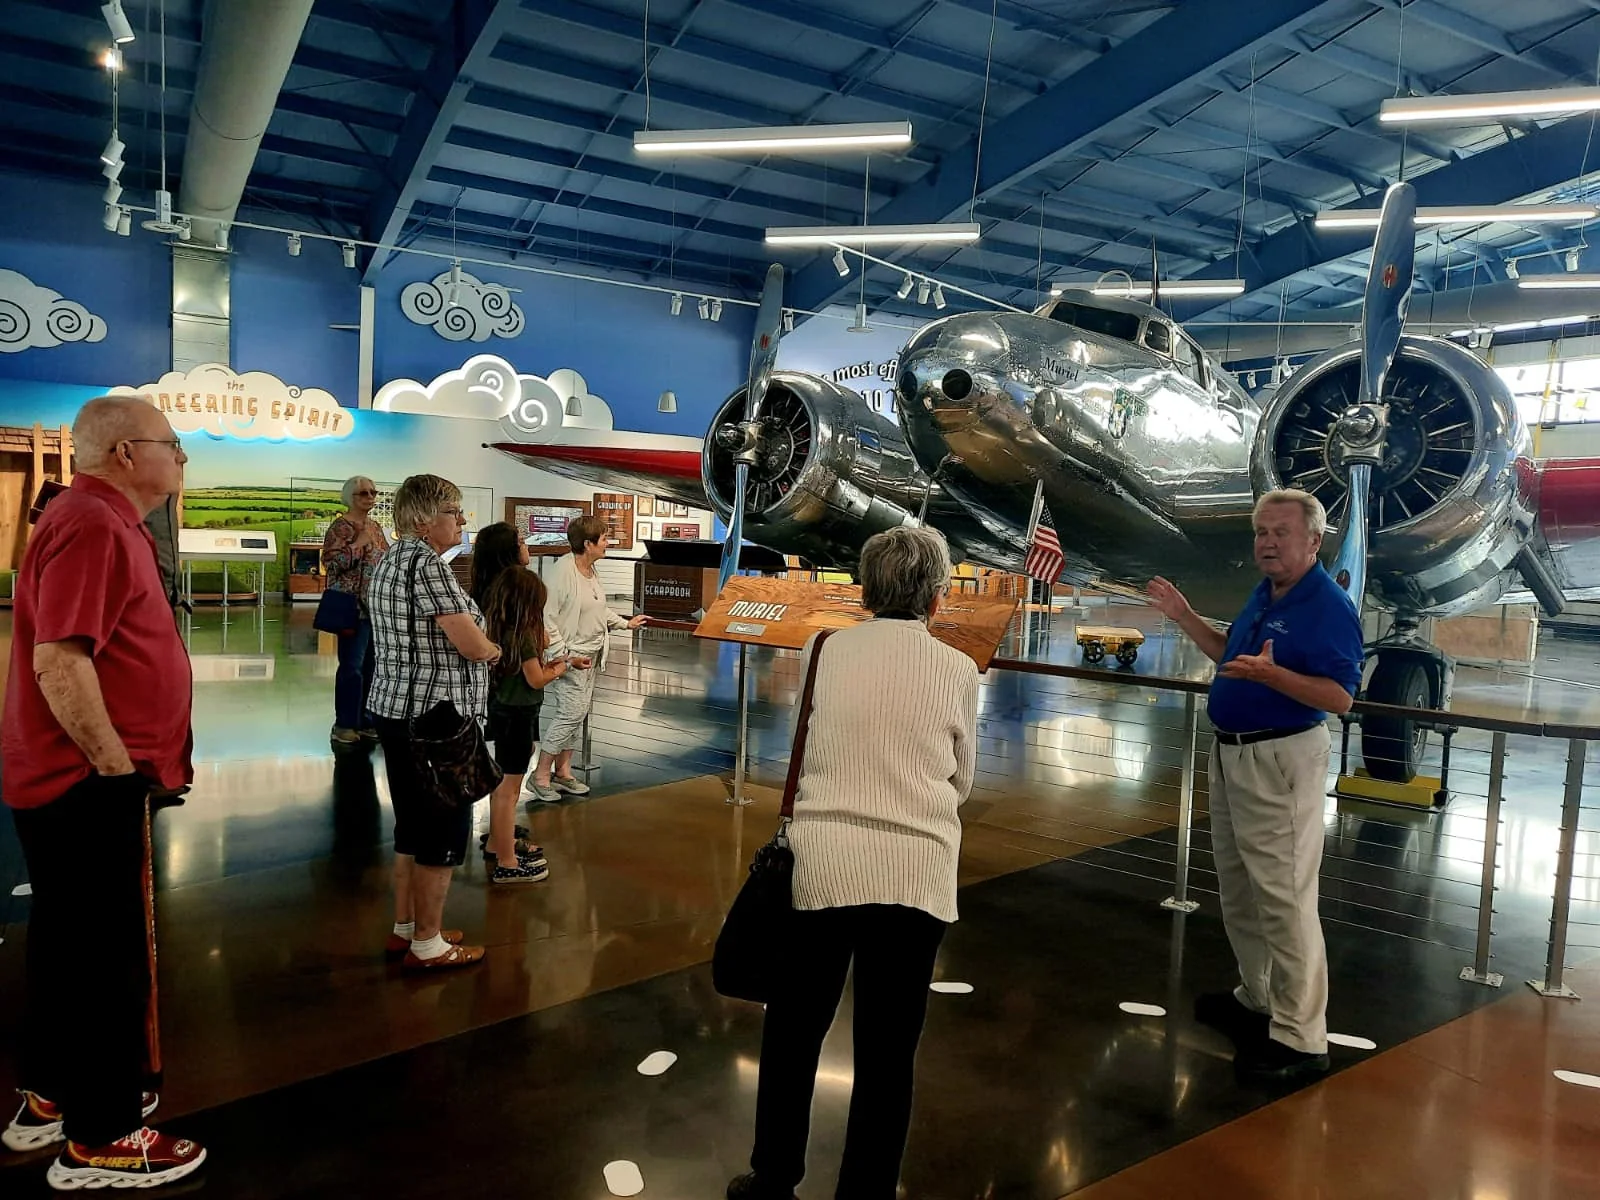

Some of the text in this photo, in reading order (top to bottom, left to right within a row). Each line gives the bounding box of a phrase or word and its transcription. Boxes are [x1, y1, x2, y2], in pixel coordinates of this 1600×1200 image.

[834, 361, 874, 384] most
[1043, 357, 1079, 382] Muriel
[227, 380, 245, 392] the
[271, 400, 342, 432] SPIRIT
[727, 600, 788, 621] MURIEL
[89, 1156, 145, 1169] CHIEFS
